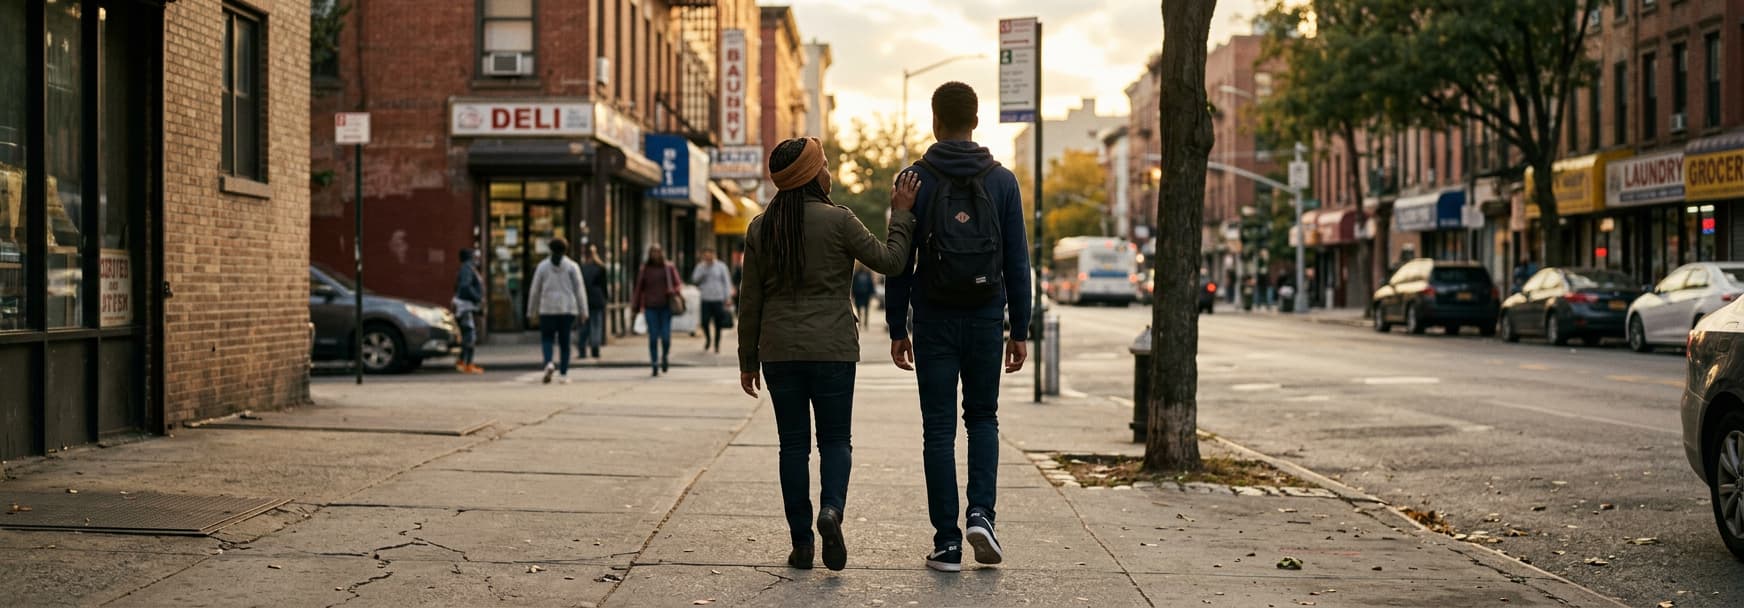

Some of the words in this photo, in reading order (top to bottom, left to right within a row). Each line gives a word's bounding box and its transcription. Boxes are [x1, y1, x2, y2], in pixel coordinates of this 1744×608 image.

[491, 107, 561, 130] DELI
[1624, 156, 1684, 188] LAUNDRY
[1688, 154, 1744, 187] GROCER
